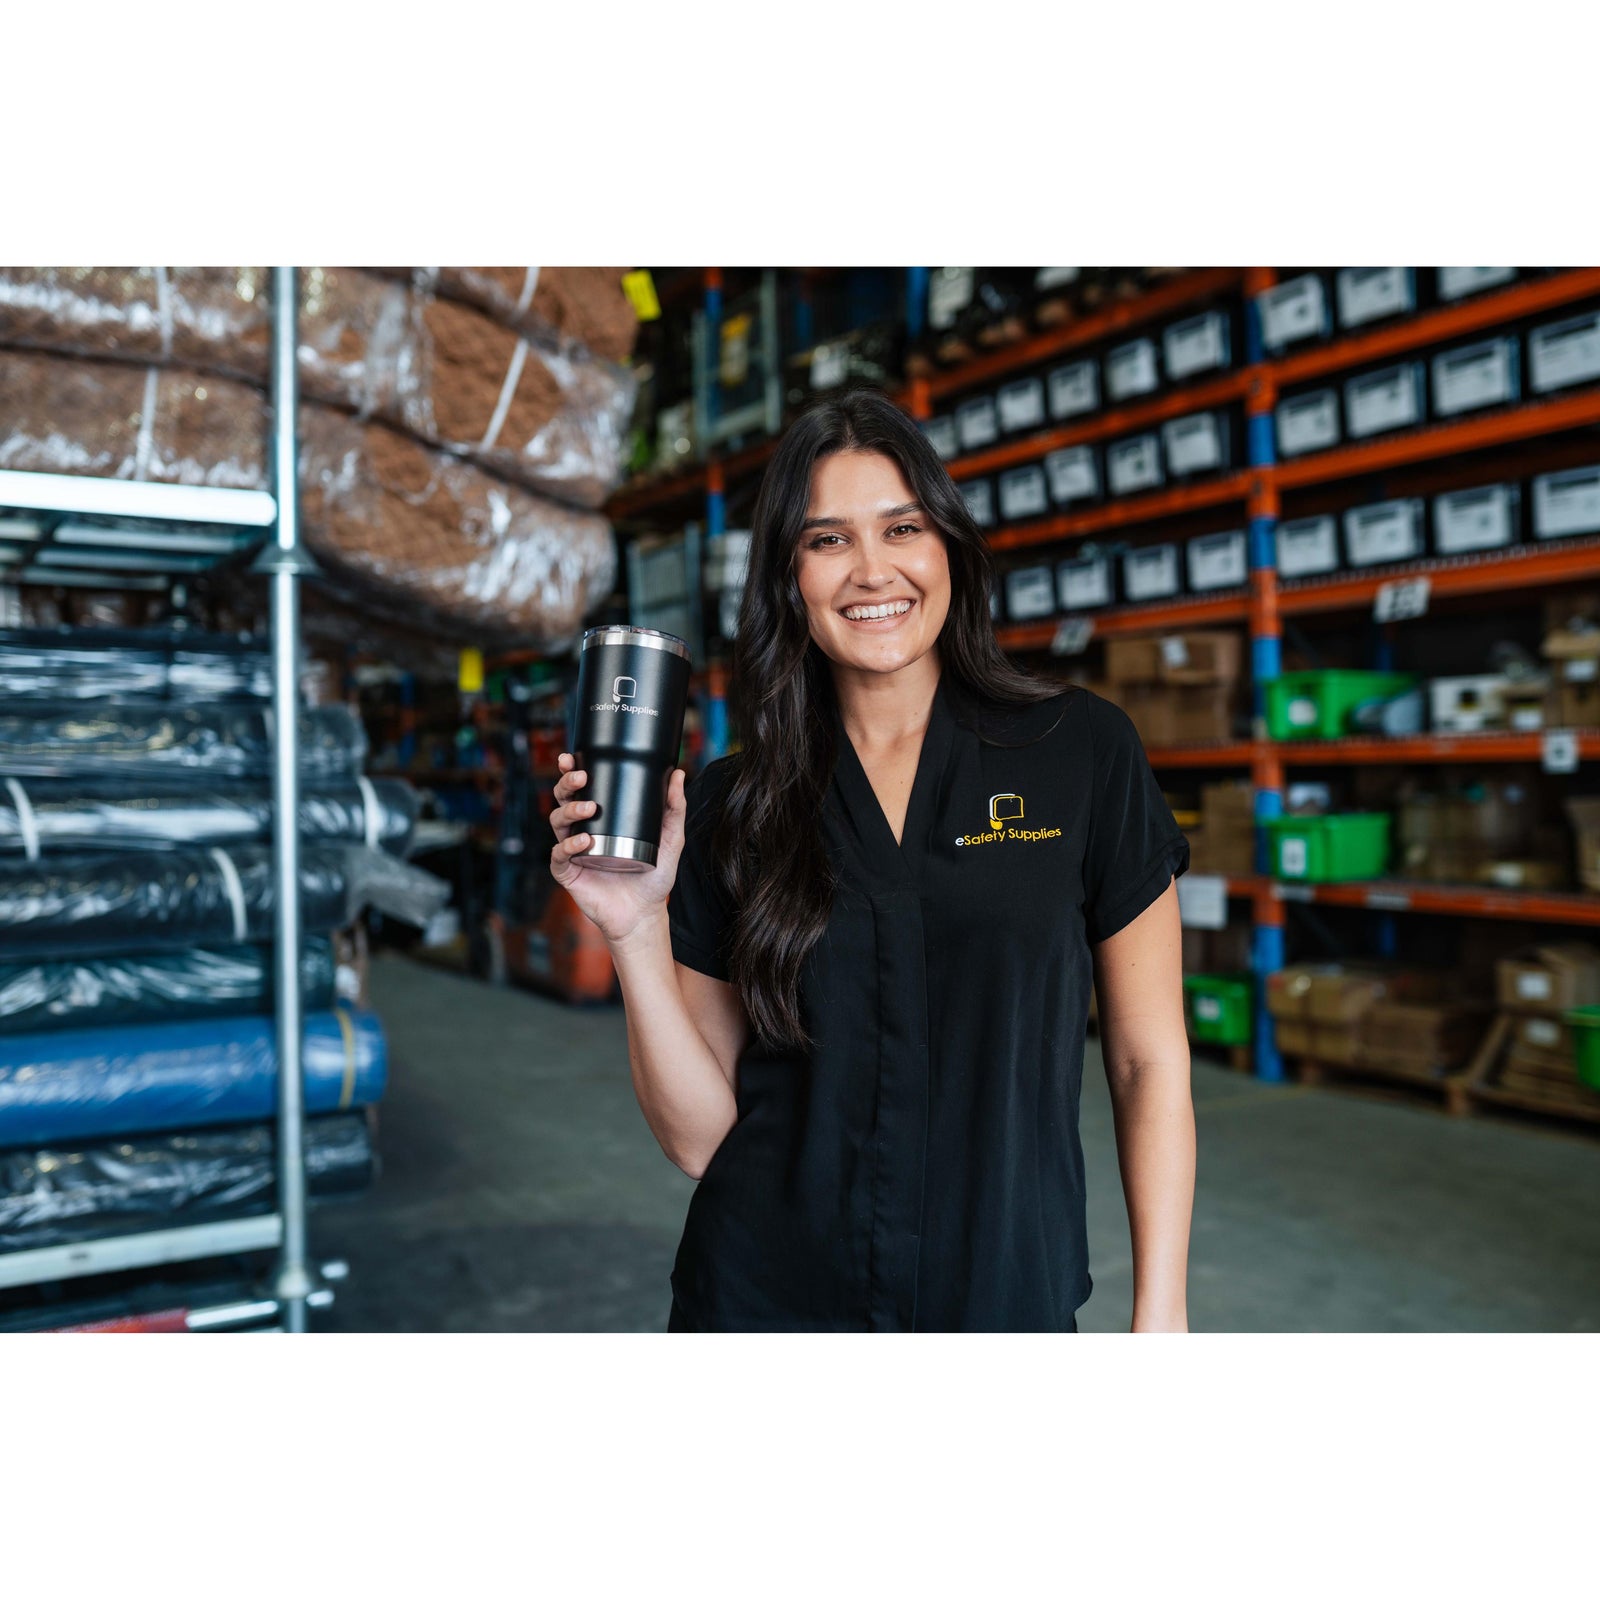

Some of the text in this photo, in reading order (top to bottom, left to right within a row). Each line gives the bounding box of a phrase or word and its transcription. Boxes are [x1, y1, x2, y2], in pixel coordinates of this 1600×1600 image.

[590, 703, 658, 716] eSafety Supplies
[955, 828, 1061, 846] eSafety Supplies
